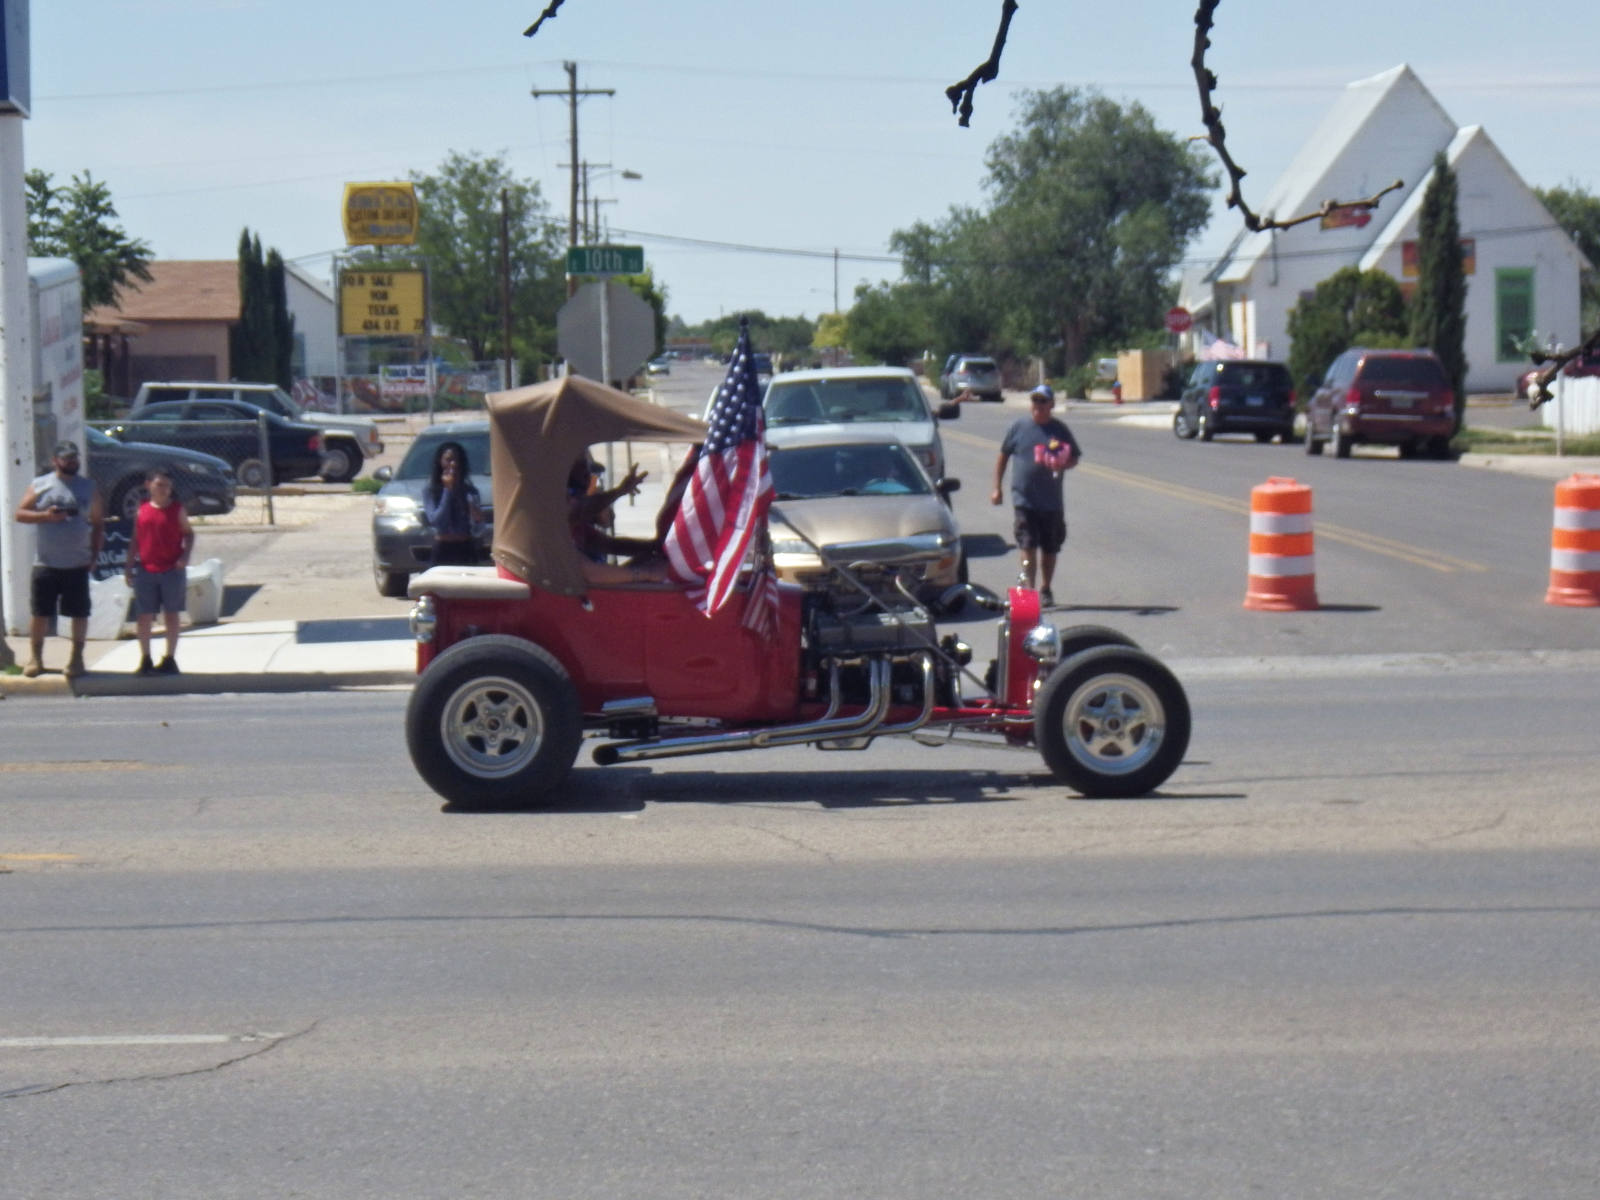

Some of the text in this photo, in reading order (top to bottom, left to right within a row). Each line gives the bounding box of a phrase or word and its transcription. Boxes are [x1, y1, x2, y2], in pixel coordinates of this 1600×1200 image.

[585, 249, 622, 270] 10th
[342, 275, 393, 286] FOR SALE
[367, 304, 399, 315] TEXAS
